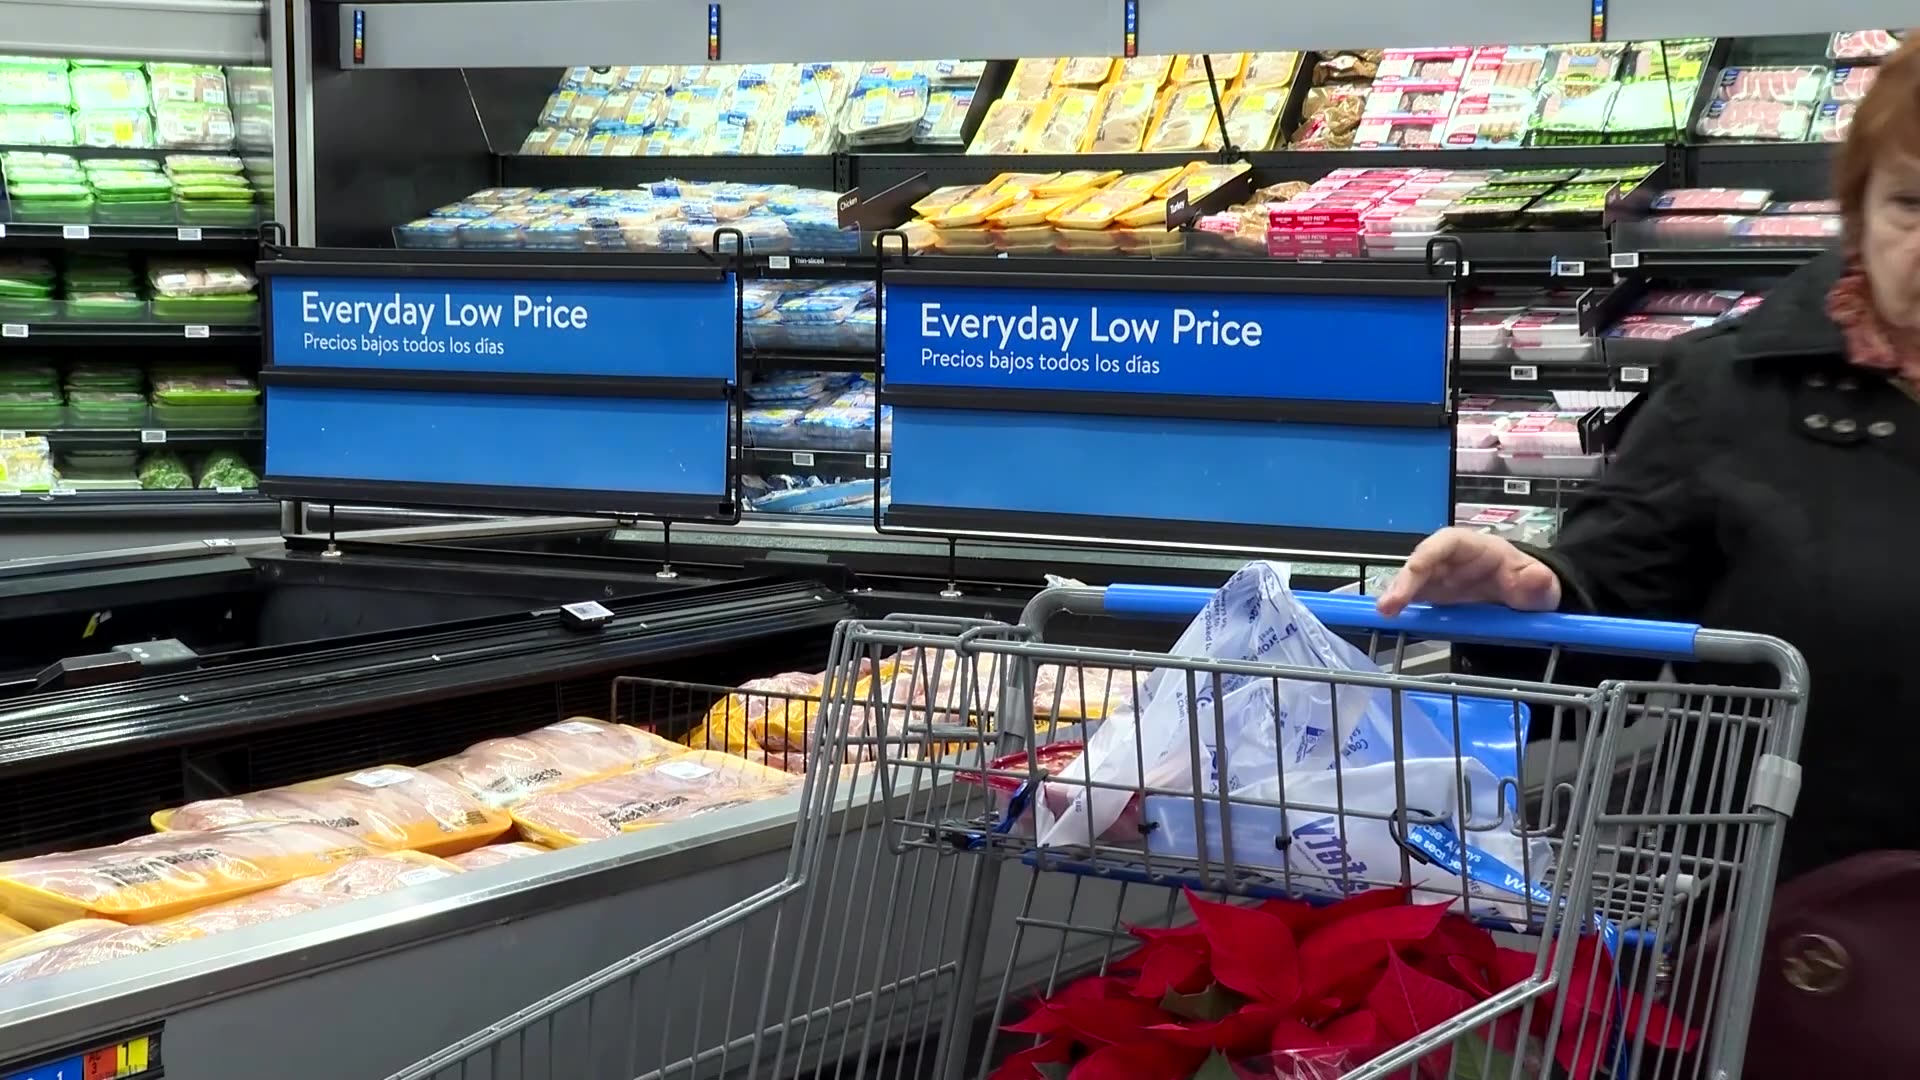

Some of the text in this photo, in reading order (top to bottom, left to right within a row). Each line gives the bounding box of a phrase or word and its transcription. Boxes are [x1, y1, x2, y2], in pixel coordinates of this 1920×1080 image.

[840, 197, 858, 211] Chicken
[1169, 200, 1185, 214] Turkey
[794, 257, 825, 265] Thin-sliced
[302, 291, 588, 335] Everyday Low Price
[921, 303, 1263, 352] Everyday Low Price
[304, 332, 504, 356] Precios bajos todos los días
[921, 348, 1160, 374] Precios bajos todos los días
[1423, 840, 1446, 860] seat
